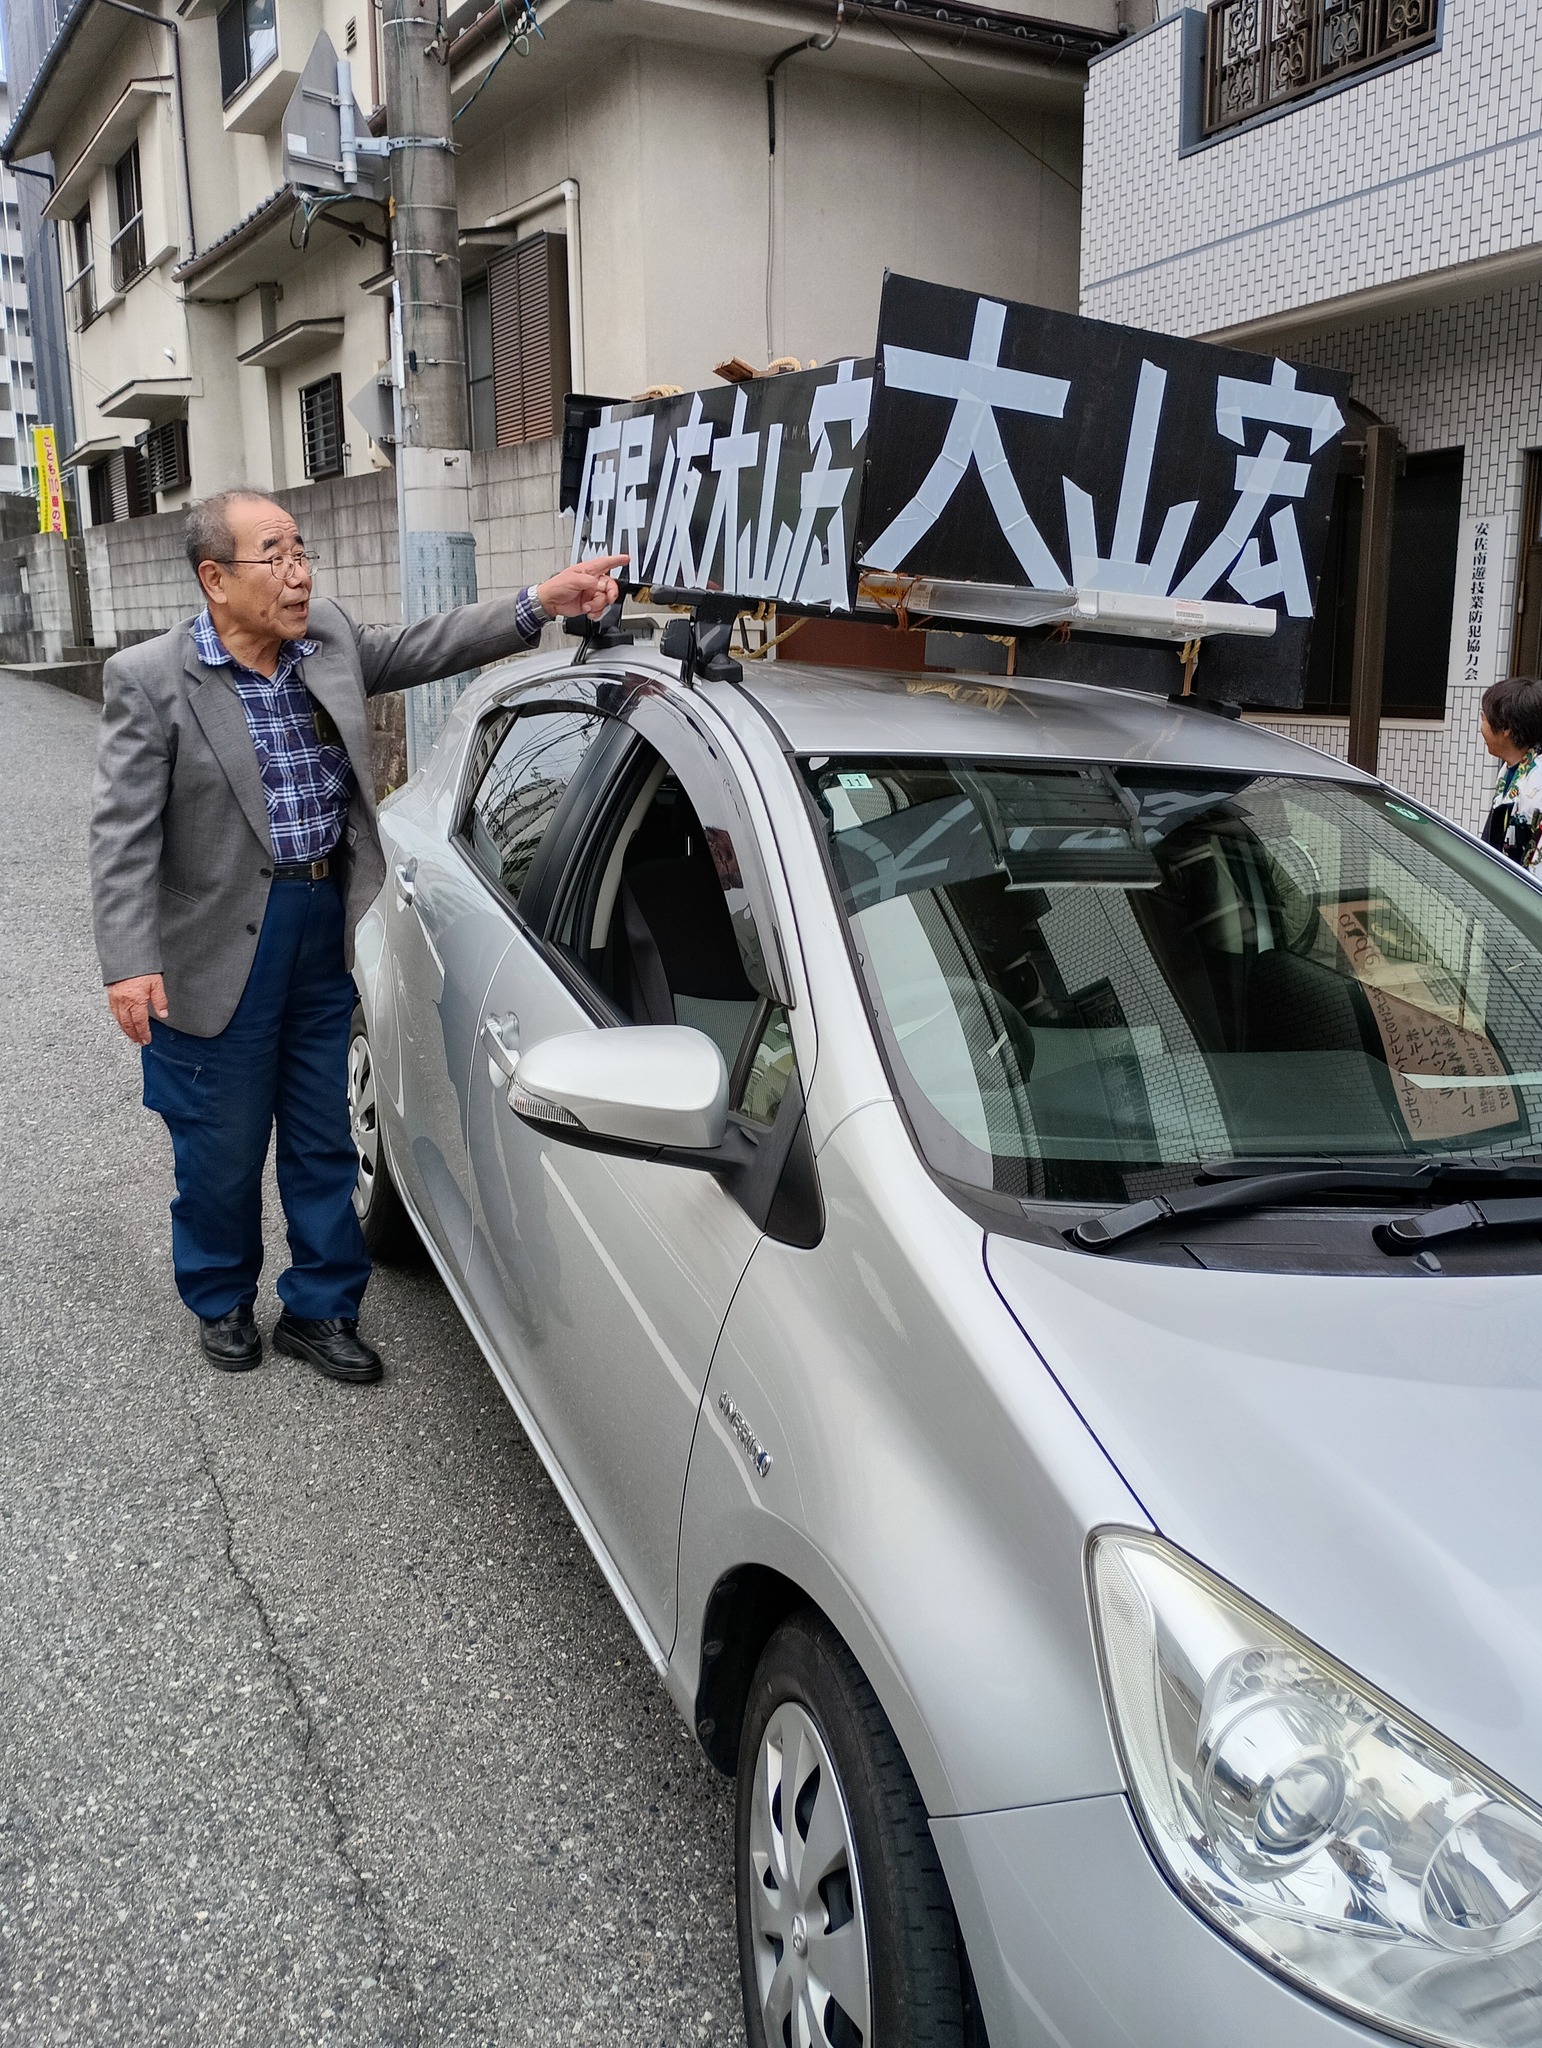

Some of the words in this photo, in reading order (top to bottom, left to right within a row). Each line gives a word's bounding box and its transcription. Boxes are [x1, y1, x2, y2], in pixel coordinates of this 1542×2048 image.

[860, 297, 1345, 617] 大山宏
[1465, 522, 1490, 681] 安佐南遊技業防犯協力会
